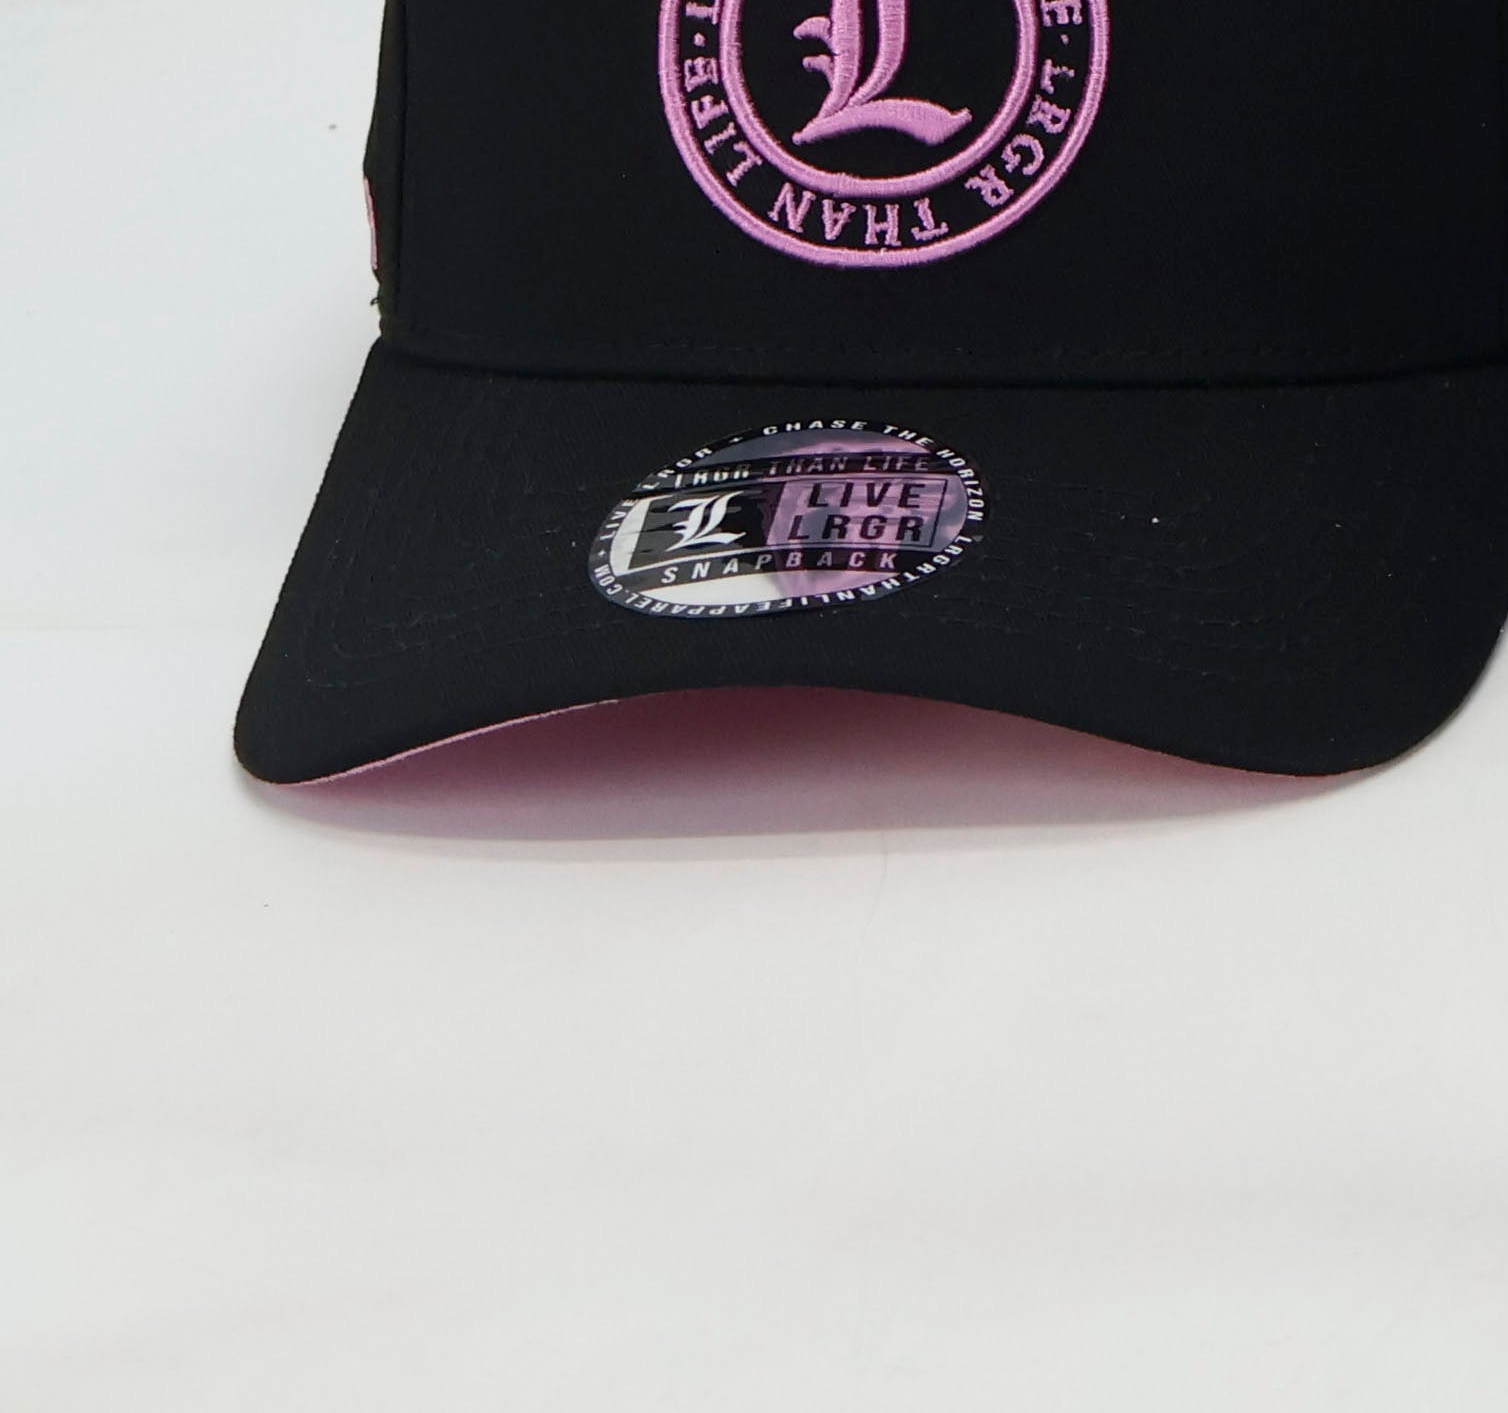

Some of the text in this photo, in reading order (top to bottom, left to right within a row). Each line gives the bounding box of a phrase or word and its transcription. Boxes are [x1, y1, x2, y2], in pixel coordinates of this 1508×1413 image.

[684, 56, 1075, 246] LRGR THAN LIFE
[762, 419, 984, 521] CHASE THE HORIZON
[769, 457, 846, 477] THAN
[863, 453, 930, 473] LIFE
[807, 481, 927, 509] LIVE
[600, 498, 638, 541] LIVE
[665, 490, 747, 552] L
[788, 514, 924, 542] LRGR
[661, 551, 900, 585] SNAPBACK
